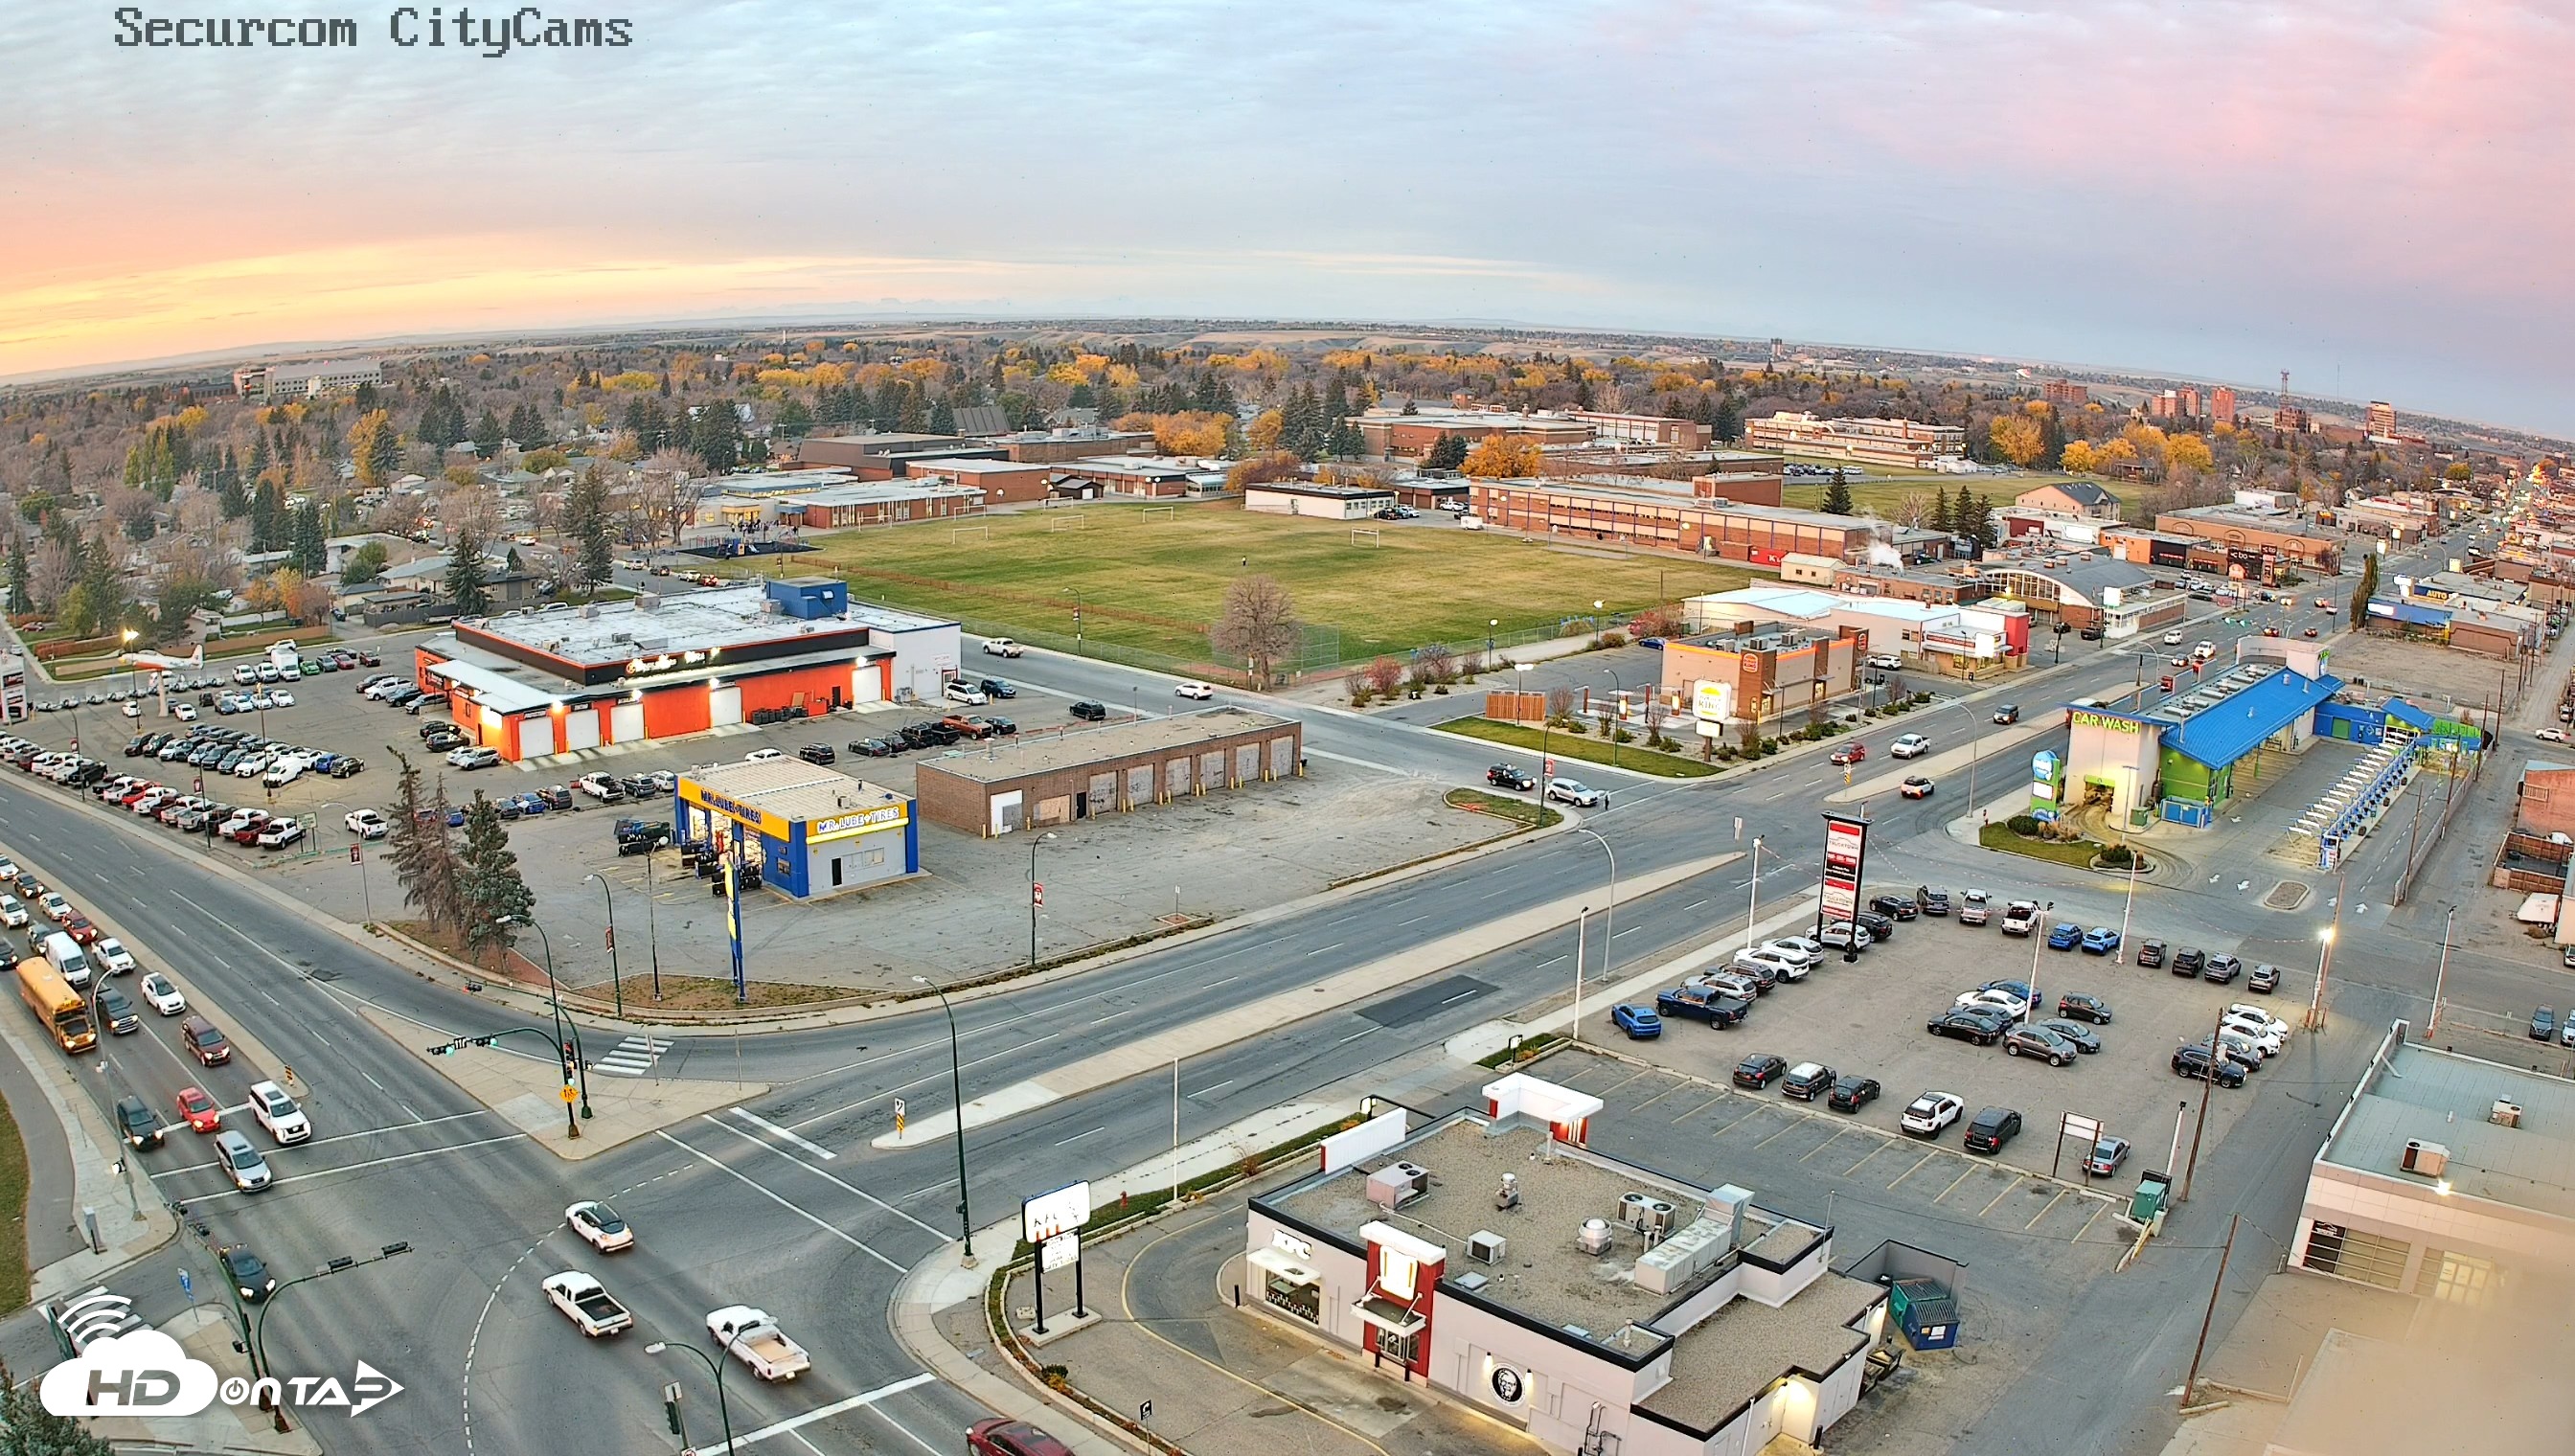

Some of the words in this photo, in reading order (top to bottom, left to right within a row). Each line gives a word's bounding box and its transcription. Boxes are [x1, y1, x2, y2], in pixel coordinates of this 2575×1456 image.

[2427, 589, 2448, 600] AUTO
[2073, 712, 2099, 727] CAR
[2102, 717, 2140, 735] WASH
[817, 819, 839, 834] MR.
[839, 814, 864, 829] LUBE
[870, 807, 900, 823] TIRES
